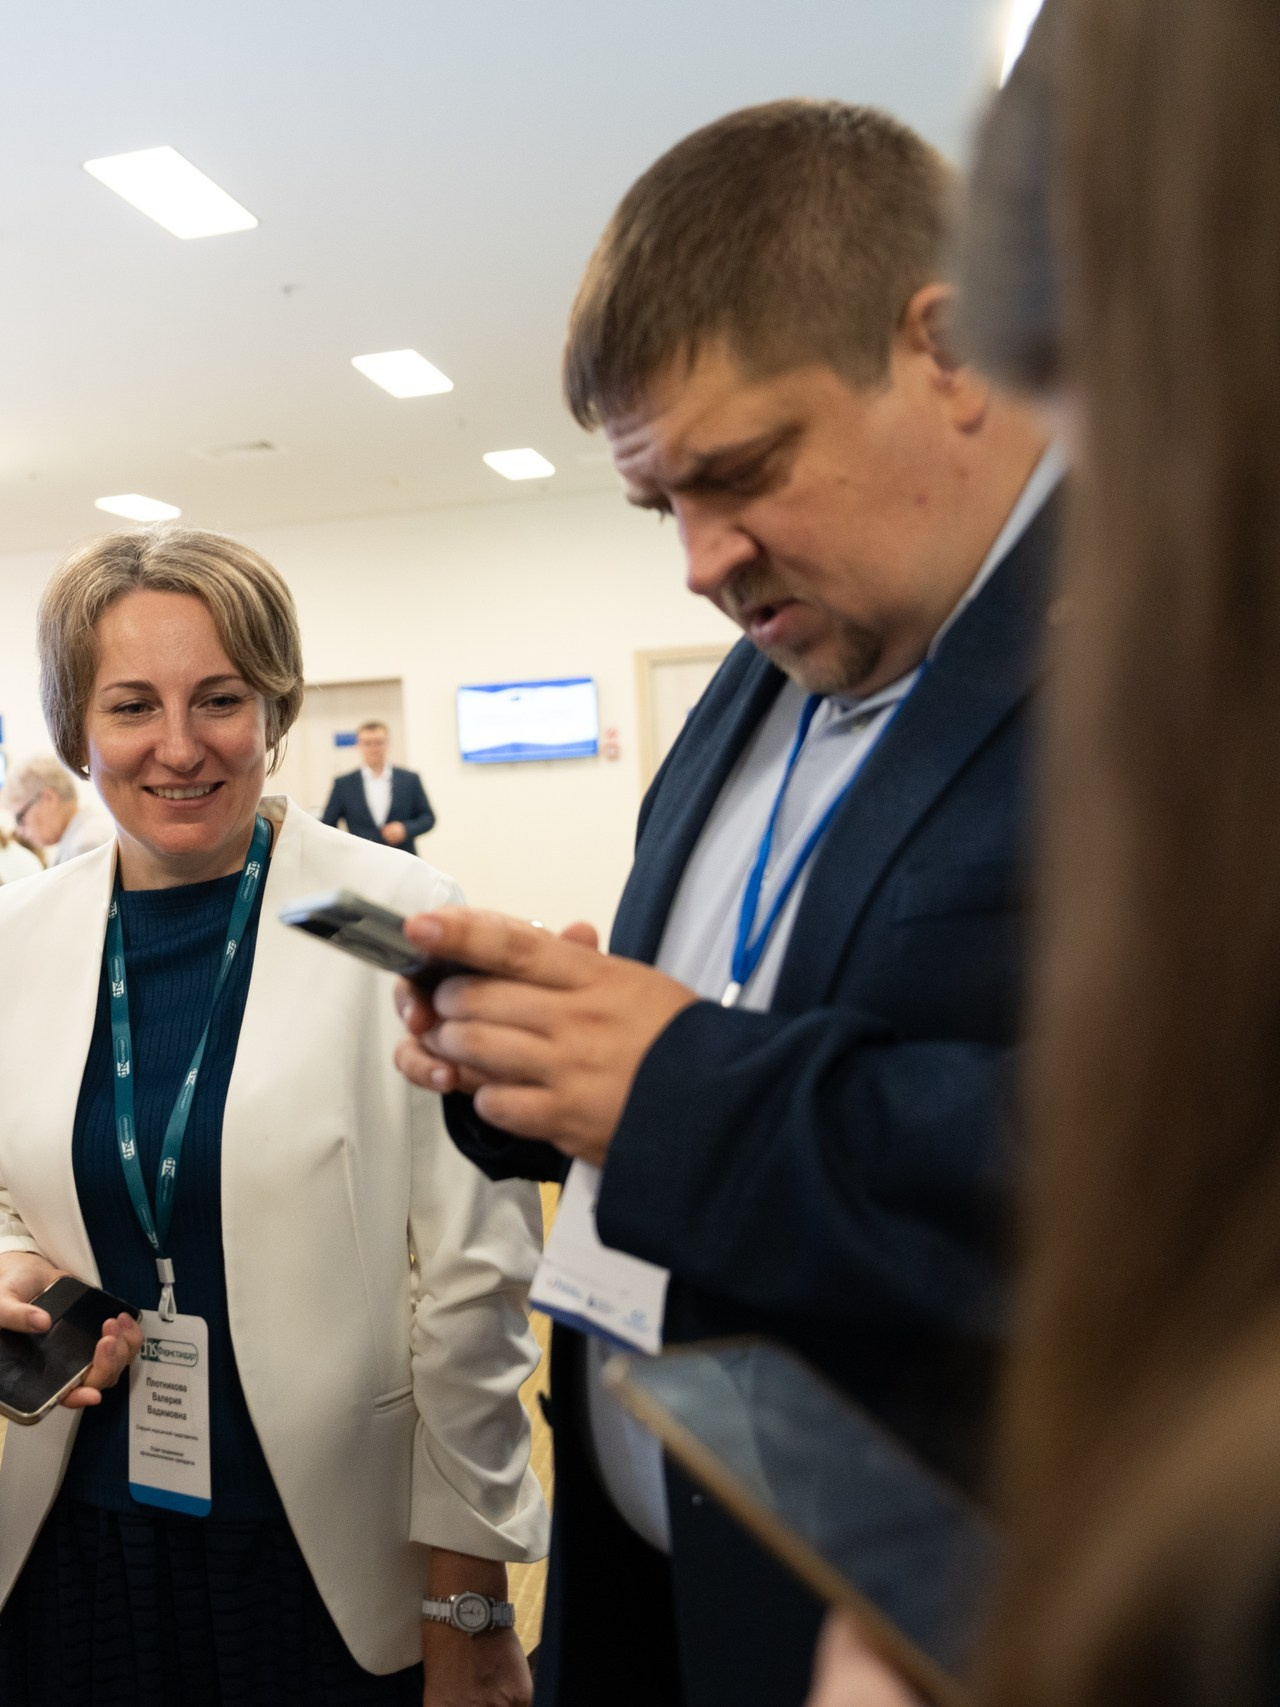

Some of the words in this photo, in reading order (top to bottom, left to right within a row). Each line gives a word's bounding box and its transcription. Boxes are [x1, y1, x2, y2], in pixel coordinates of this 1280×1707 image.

[146, 1376, 187, 1393] Плотникова
[152, 1391, 182, 1405] Валерия
[147, 1404, 187, 1420] Вадимовна
